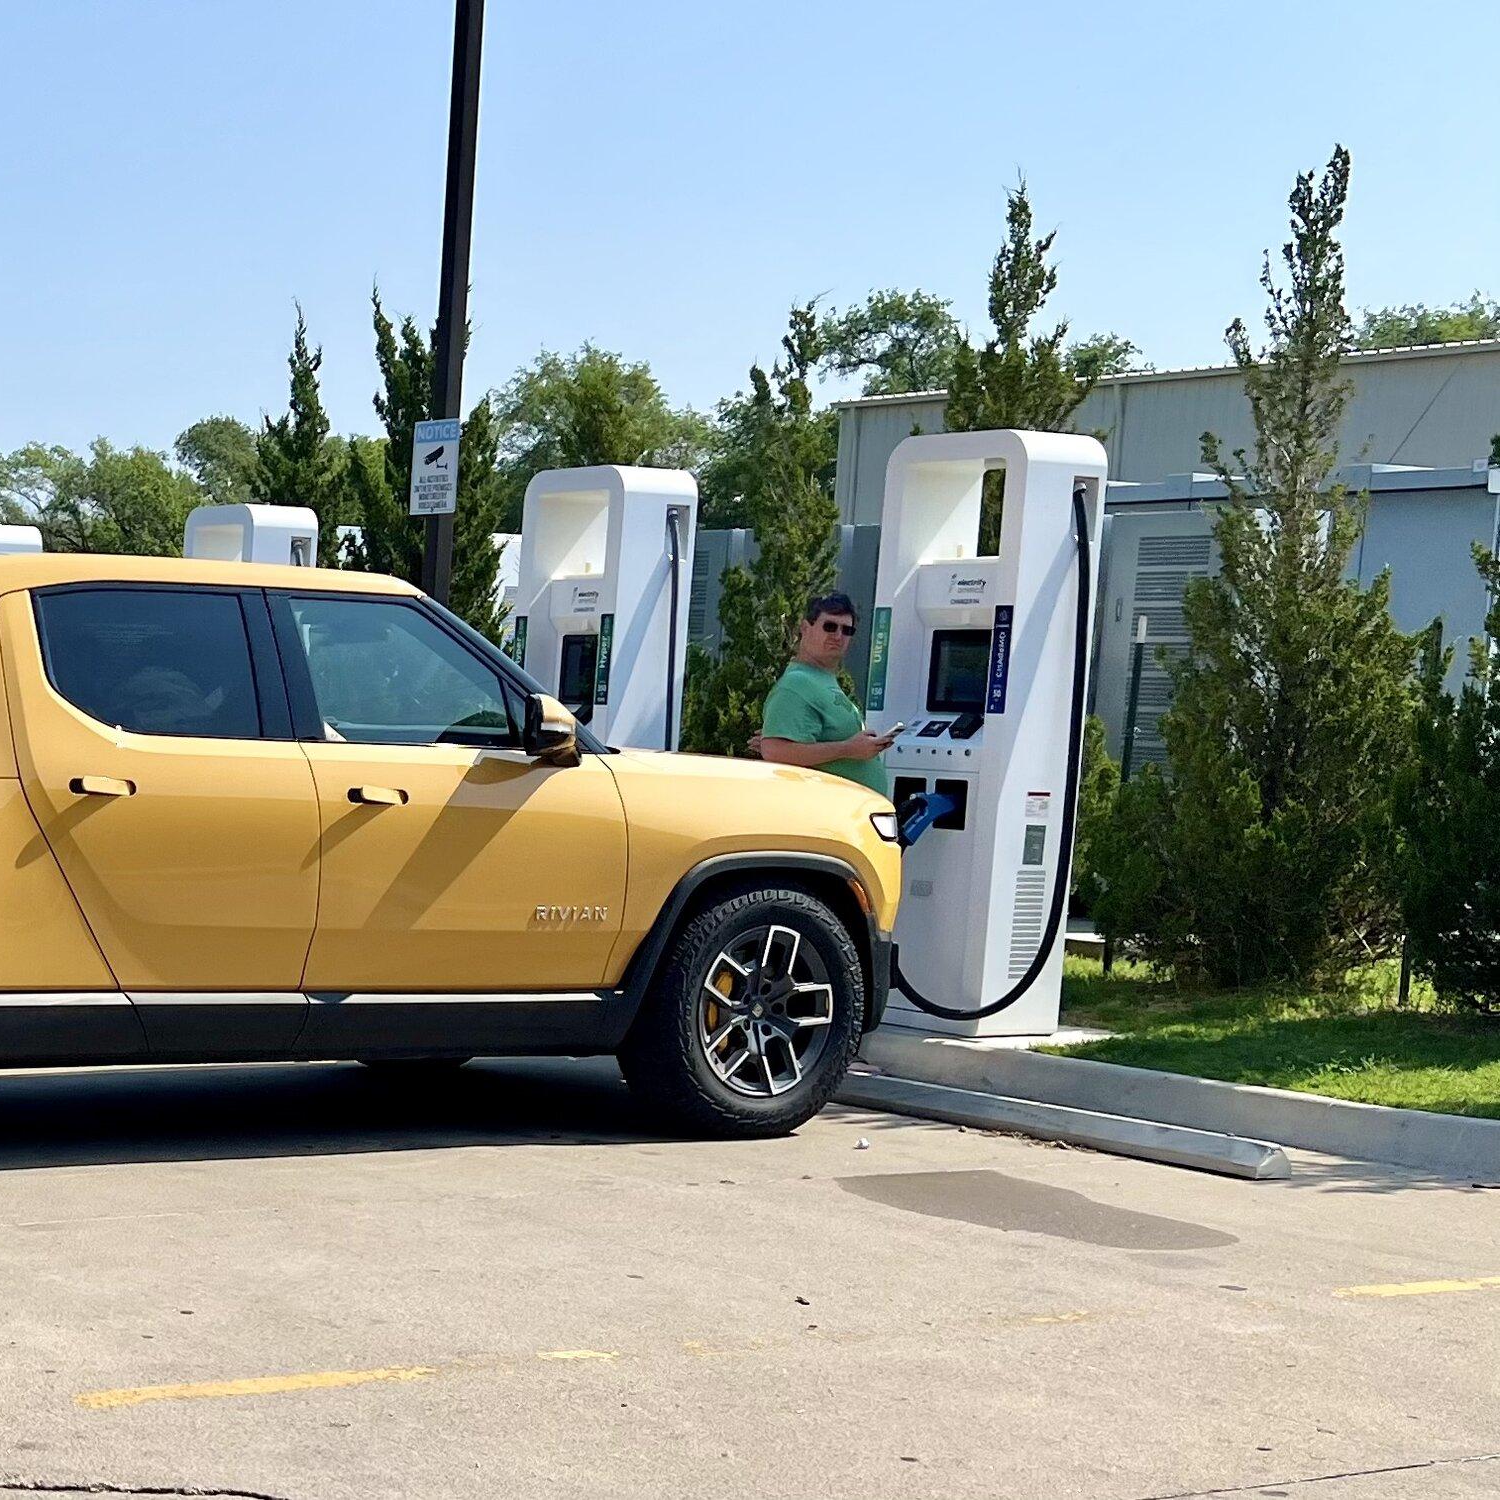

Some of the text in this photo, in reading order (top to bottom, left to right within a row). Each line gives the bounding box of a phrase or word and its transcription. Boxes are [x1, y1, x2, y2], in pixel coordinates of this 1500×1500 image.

[418, 423, 457, 440] NOTICE
[874, 632, 884, 663] Ultra
[536, 905, 608, 921] RIVIAN
